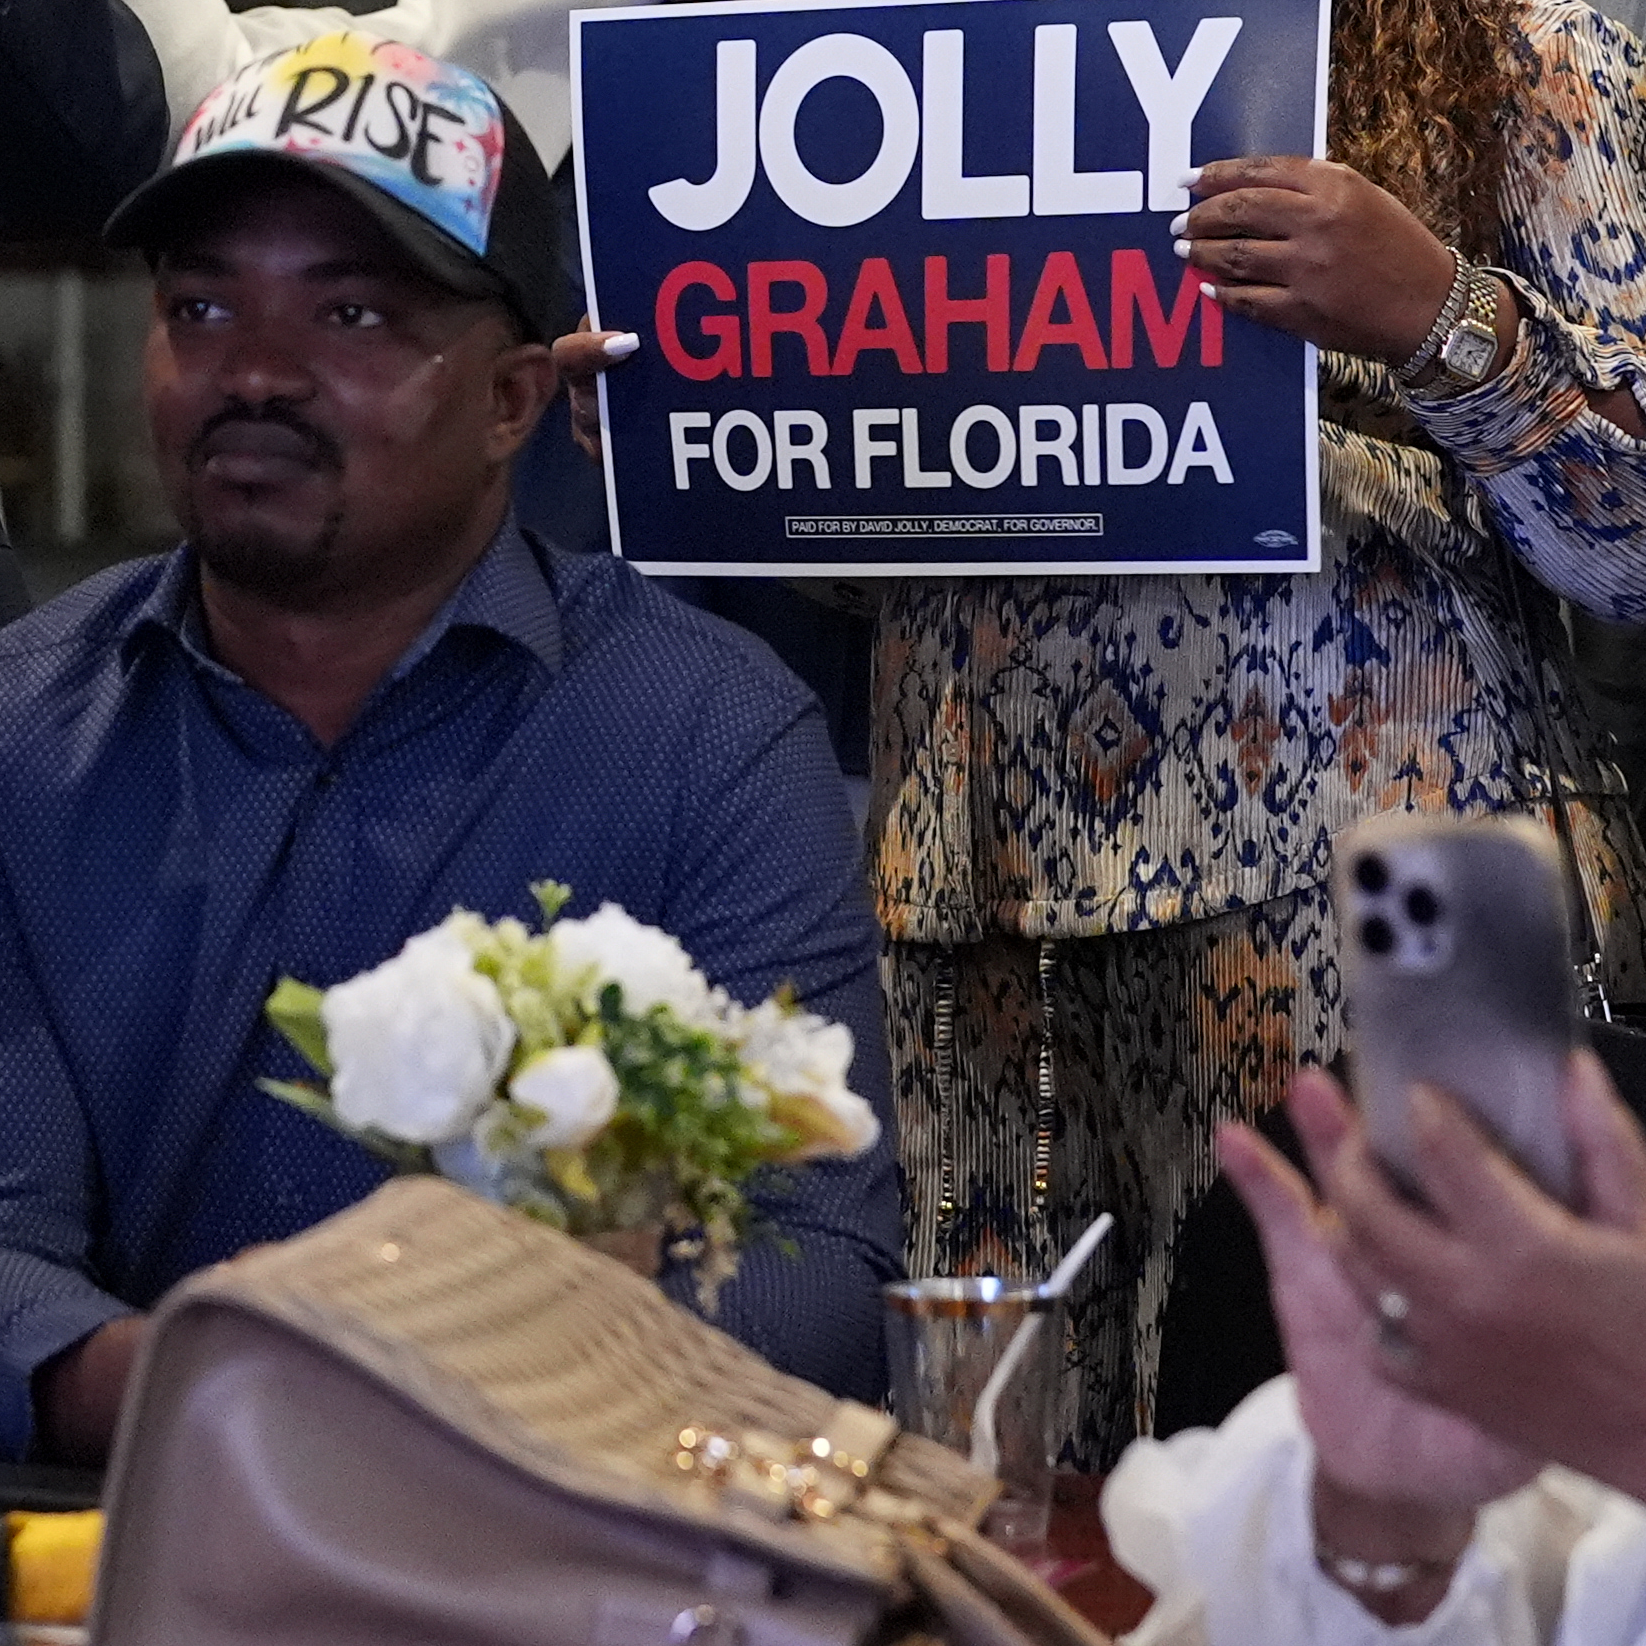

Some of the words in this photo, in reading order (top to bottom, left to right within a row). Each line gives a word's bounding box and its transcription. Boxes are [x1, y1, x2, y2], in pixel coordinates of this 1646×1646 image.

[275, 65, 464, 186] RISE
[648, 17, 1243, 231] JOLLY
[655, 249, 1224, 381] GRAHAM
[669, 409, 832, 492] FOR
[852, 401, 1234, 489] FLORIDA
[791, 521, 817, 533] PAID
[818, 521, 841, 533] FOR
[842, 521, 856, 532] BY
[859, 521, 893, 532] DAVID
[894, 520, 932, 533] JOLLY,
[1003, 519, 1028, 531] FOR
